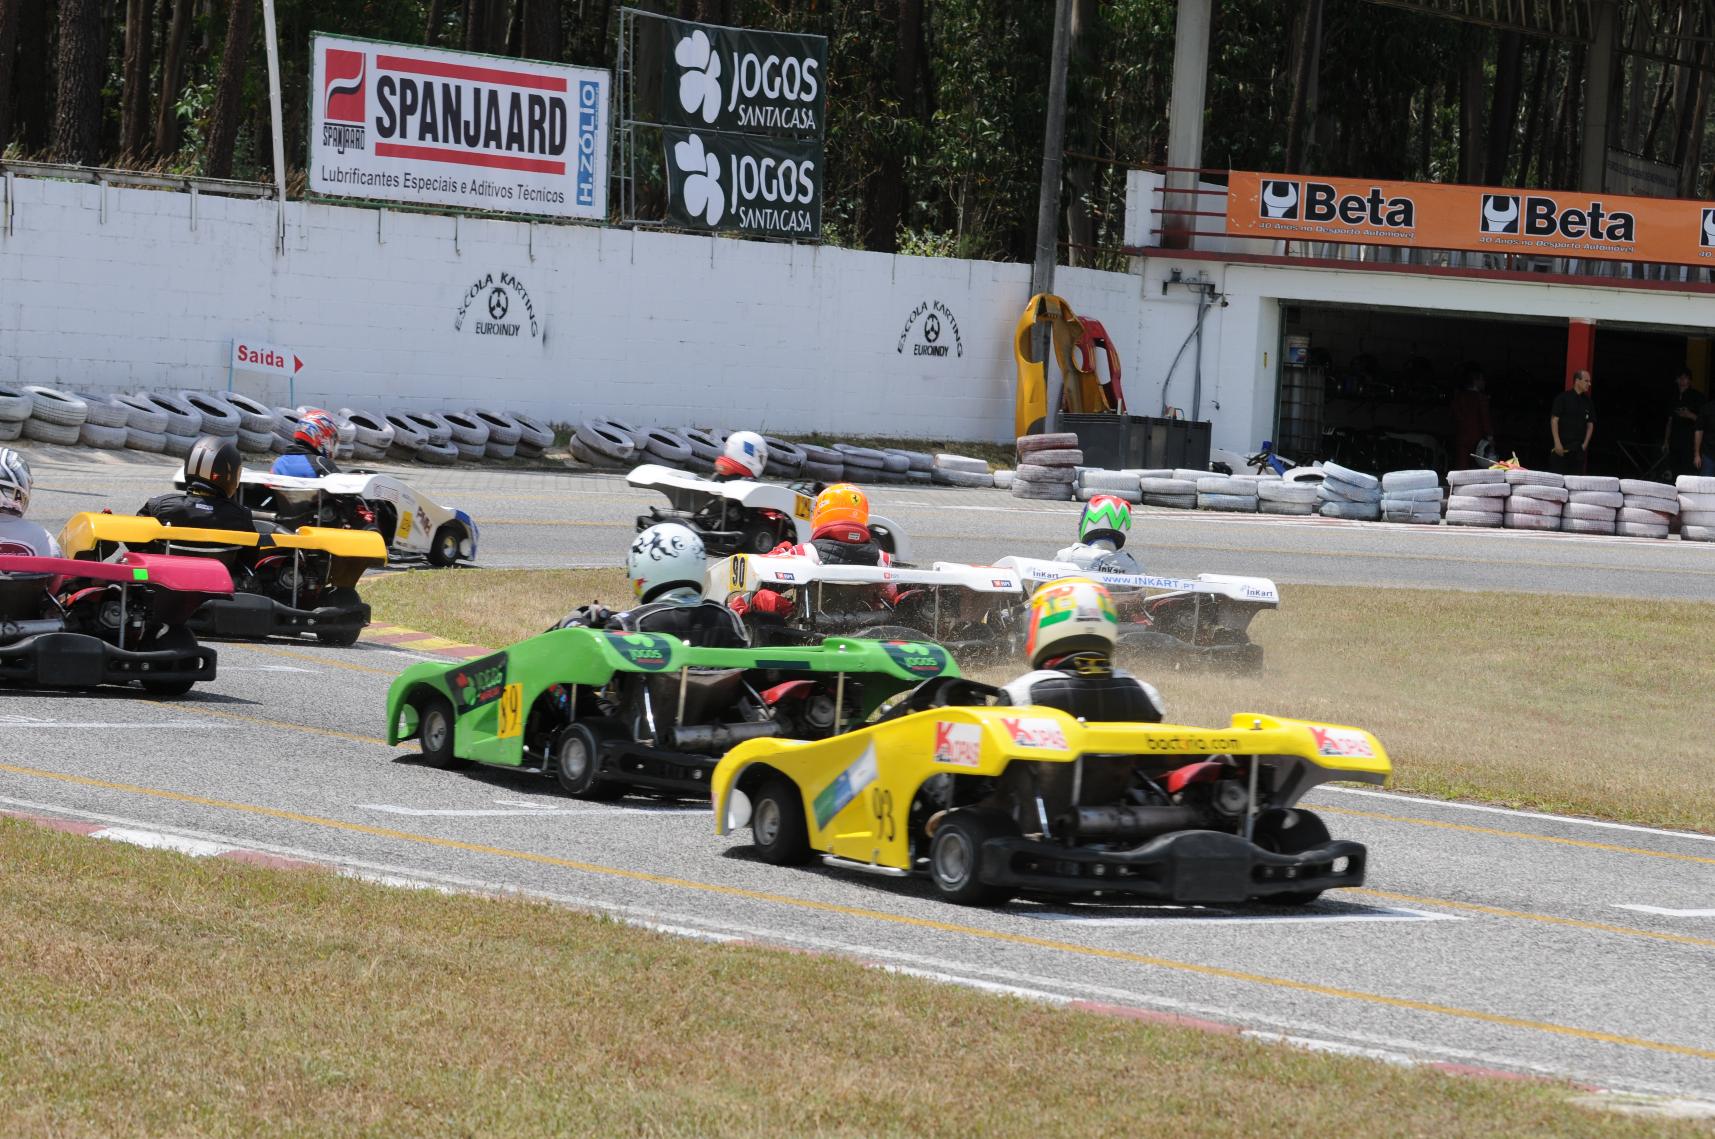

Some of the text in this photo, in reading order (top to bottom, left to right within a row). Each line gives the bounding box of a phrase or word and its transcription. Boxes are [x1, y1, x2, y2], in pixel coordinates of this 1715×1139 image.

[728, 52, 819, 113] JOGOS
[375, 75, 567, 156] SPANJAARD
[322, 125, 366, 155] SPANJAARD
[321, 165, 565, 204] Lubrificantes Especiais e Aditivos Técnicos
[730, 154, 815, 215] JOGOS
[1303, 182, 1416, 228] Beta
[1524, 195, 1636, 243] Beta
[455, 272, 539, 338] ESCOLA KARTING
[475, 321, 521, 337] EUROINDY
[897, 300, 963, 358] ESCOLA KARTING
[913, 344, 949, 357] EUROINDY
[732, 555, 746, 588] 90
[872, 786, 896, 842] 93
